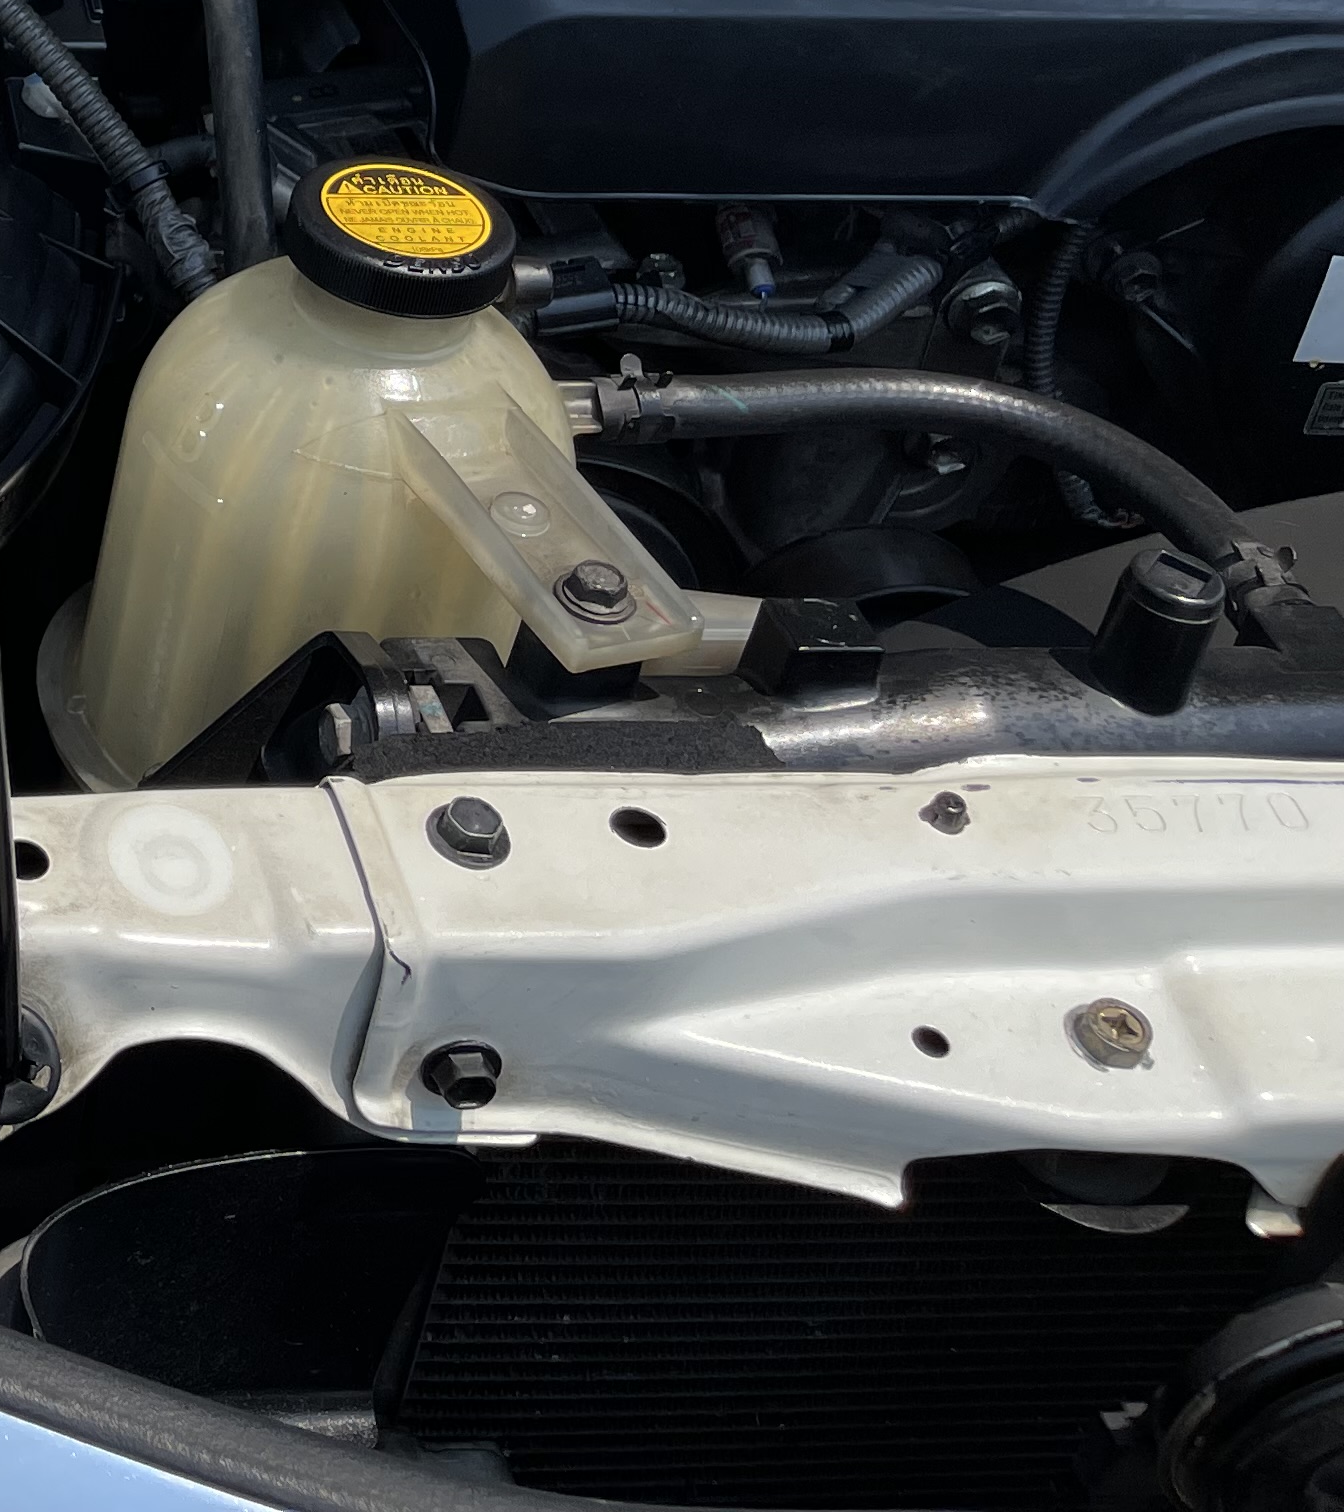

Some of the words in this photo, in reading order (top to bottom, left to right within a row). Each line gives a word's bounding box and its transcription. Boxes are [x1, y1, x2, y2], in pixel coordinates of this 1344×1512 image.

[363, 185, 448, 195] CAUTION
[377, 226, 456, 234] ENGINE
[375, 235, 465, 243] COOLANT
[1074, 791, 1310, 834] 35770
